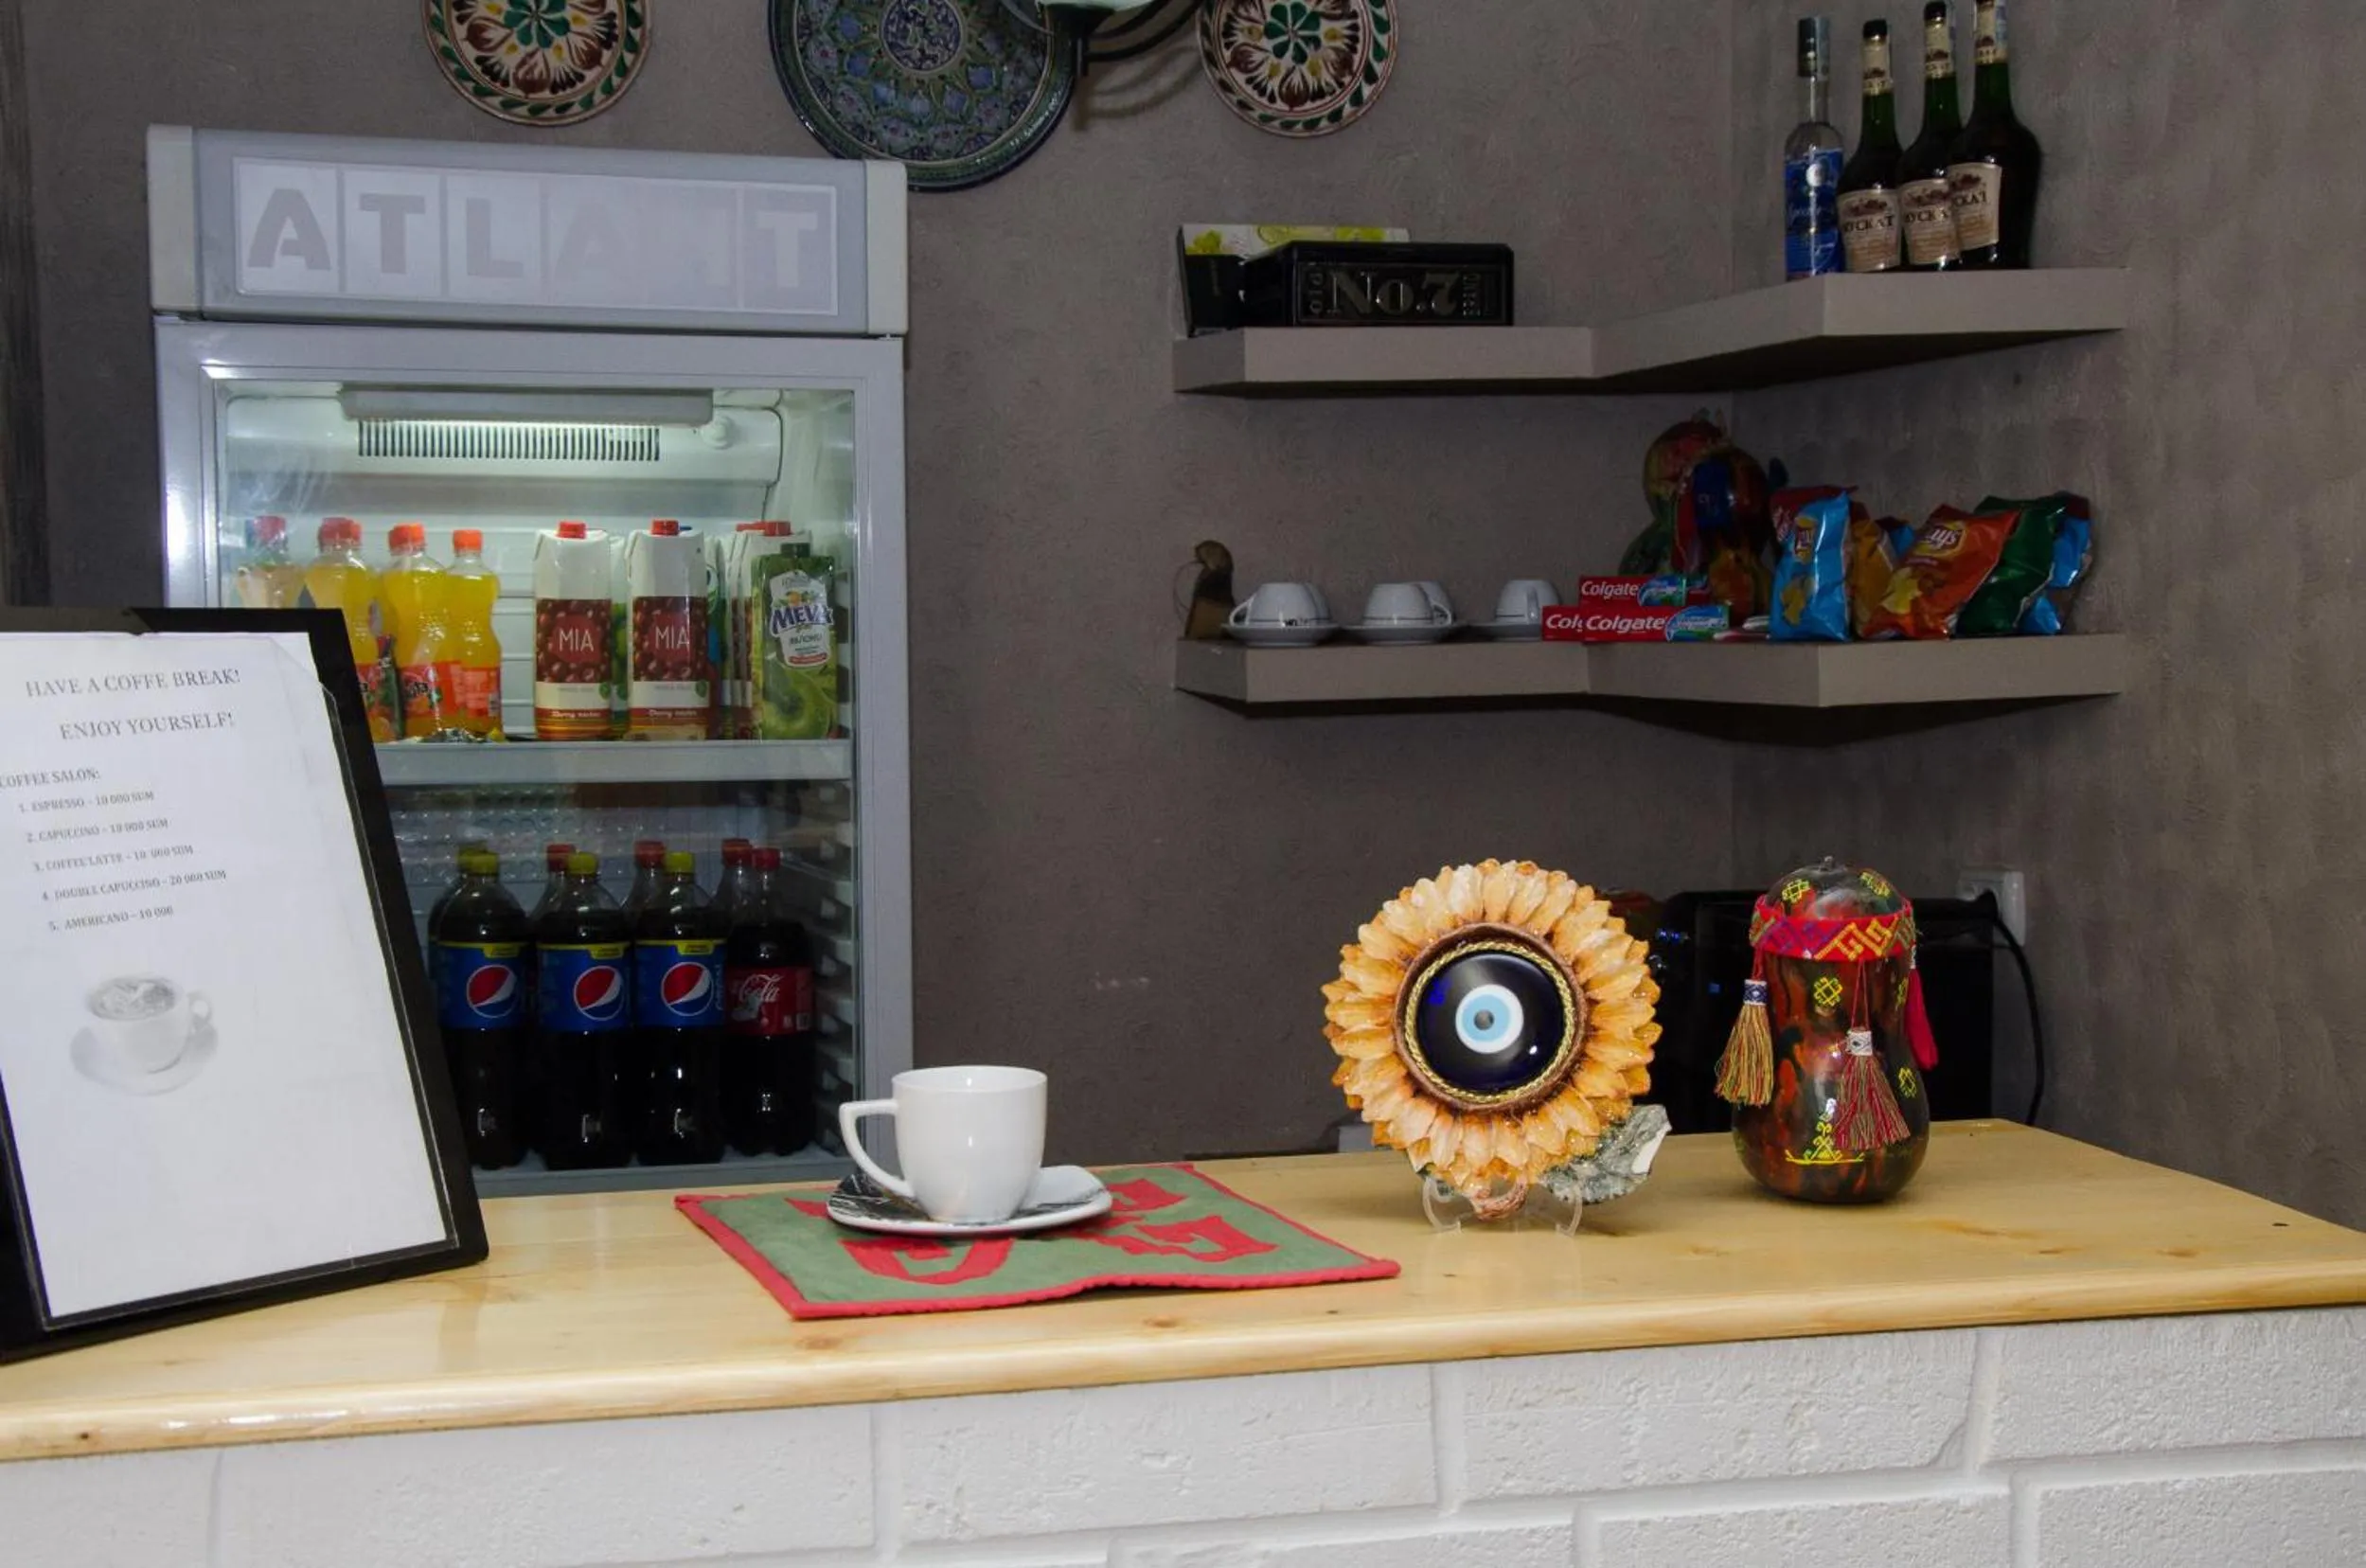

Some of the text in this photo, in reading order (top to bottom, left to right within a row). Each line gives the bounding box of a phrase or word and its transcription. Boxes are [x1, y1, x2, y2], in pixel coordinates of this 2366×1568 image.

[1327, 269, 1461, 315] No.7
[1581, 580, 1639, 600] Colgate
[1586, 614, 1666, 634] Colgate
[559, 629, 595, 652] MIA
[655, 626, 690, 650] MIA
[26, 678, 83, 698] HAVE
[87, 677, 100, 694] A
[172, 668, 240, 688] BREAK!
[60, 711, 234, 740] ENJOY YOURSELF!
[51, 766, 100, 784] SALON:
[31, 797, 85, 812] ESPRESSO
[38, 825, 100, 842] CAPUCCINO
[54, 883, 98, 900] DOUBLE
[99, 877, 161, 895] CAPUCCINO
[63, 911, 129, 930] AMERICANO
